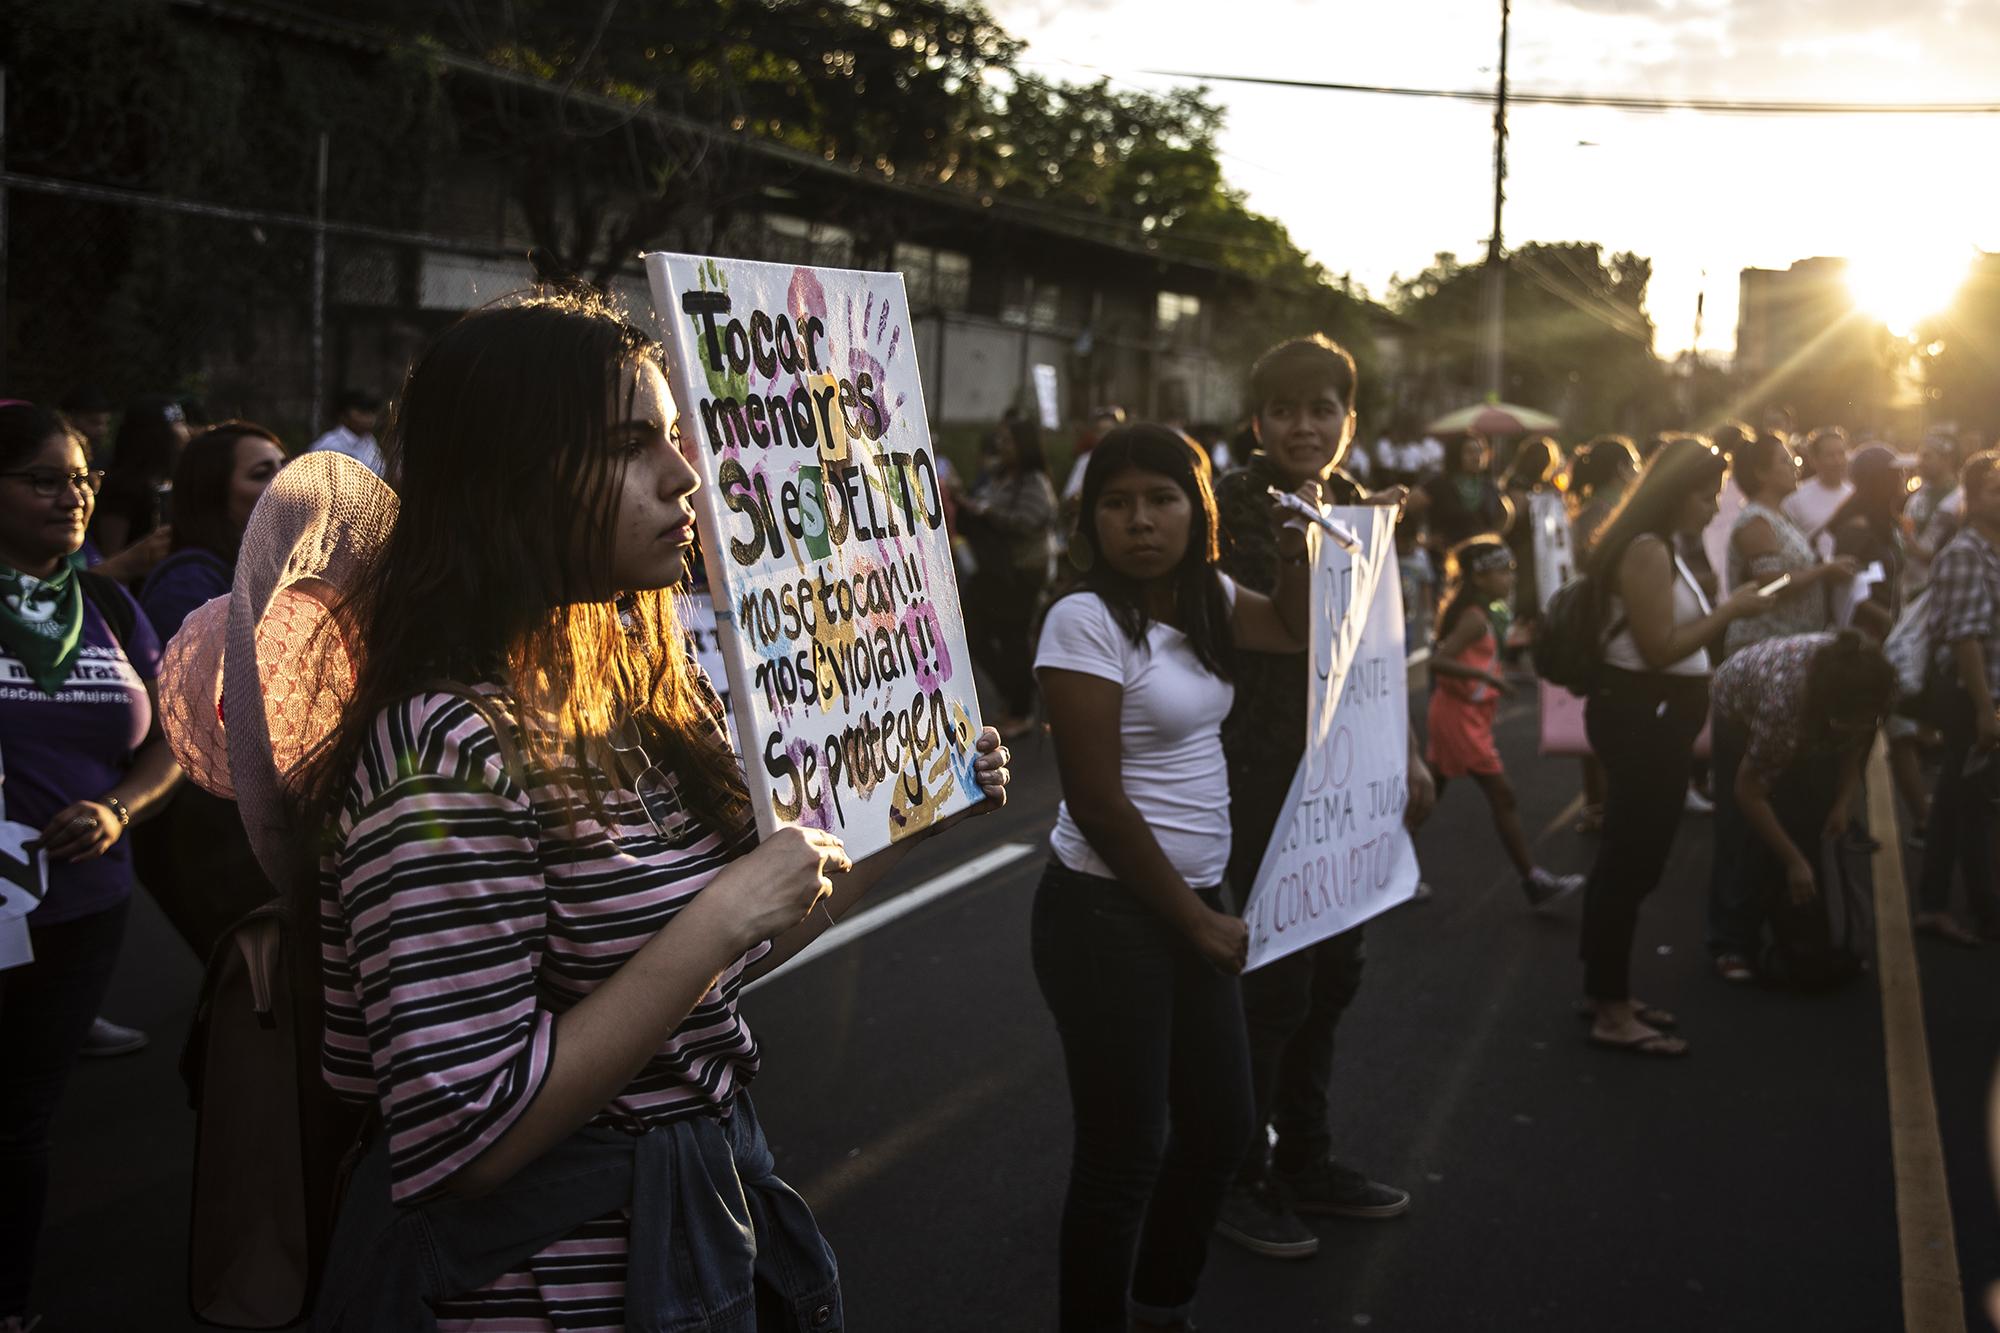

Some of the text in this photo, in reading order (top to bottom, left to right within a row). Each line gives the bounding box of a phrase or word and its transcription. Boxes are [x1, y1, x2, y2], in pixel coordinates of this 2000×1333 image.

[682, 291, 824, 379] Tocar
[700, 372, 884, 455] menores
[823, 448, 942, 546] DELITO
[763, 731, 822, 822] Se
[1273, 831, 1393, 933] CORRUPTO
